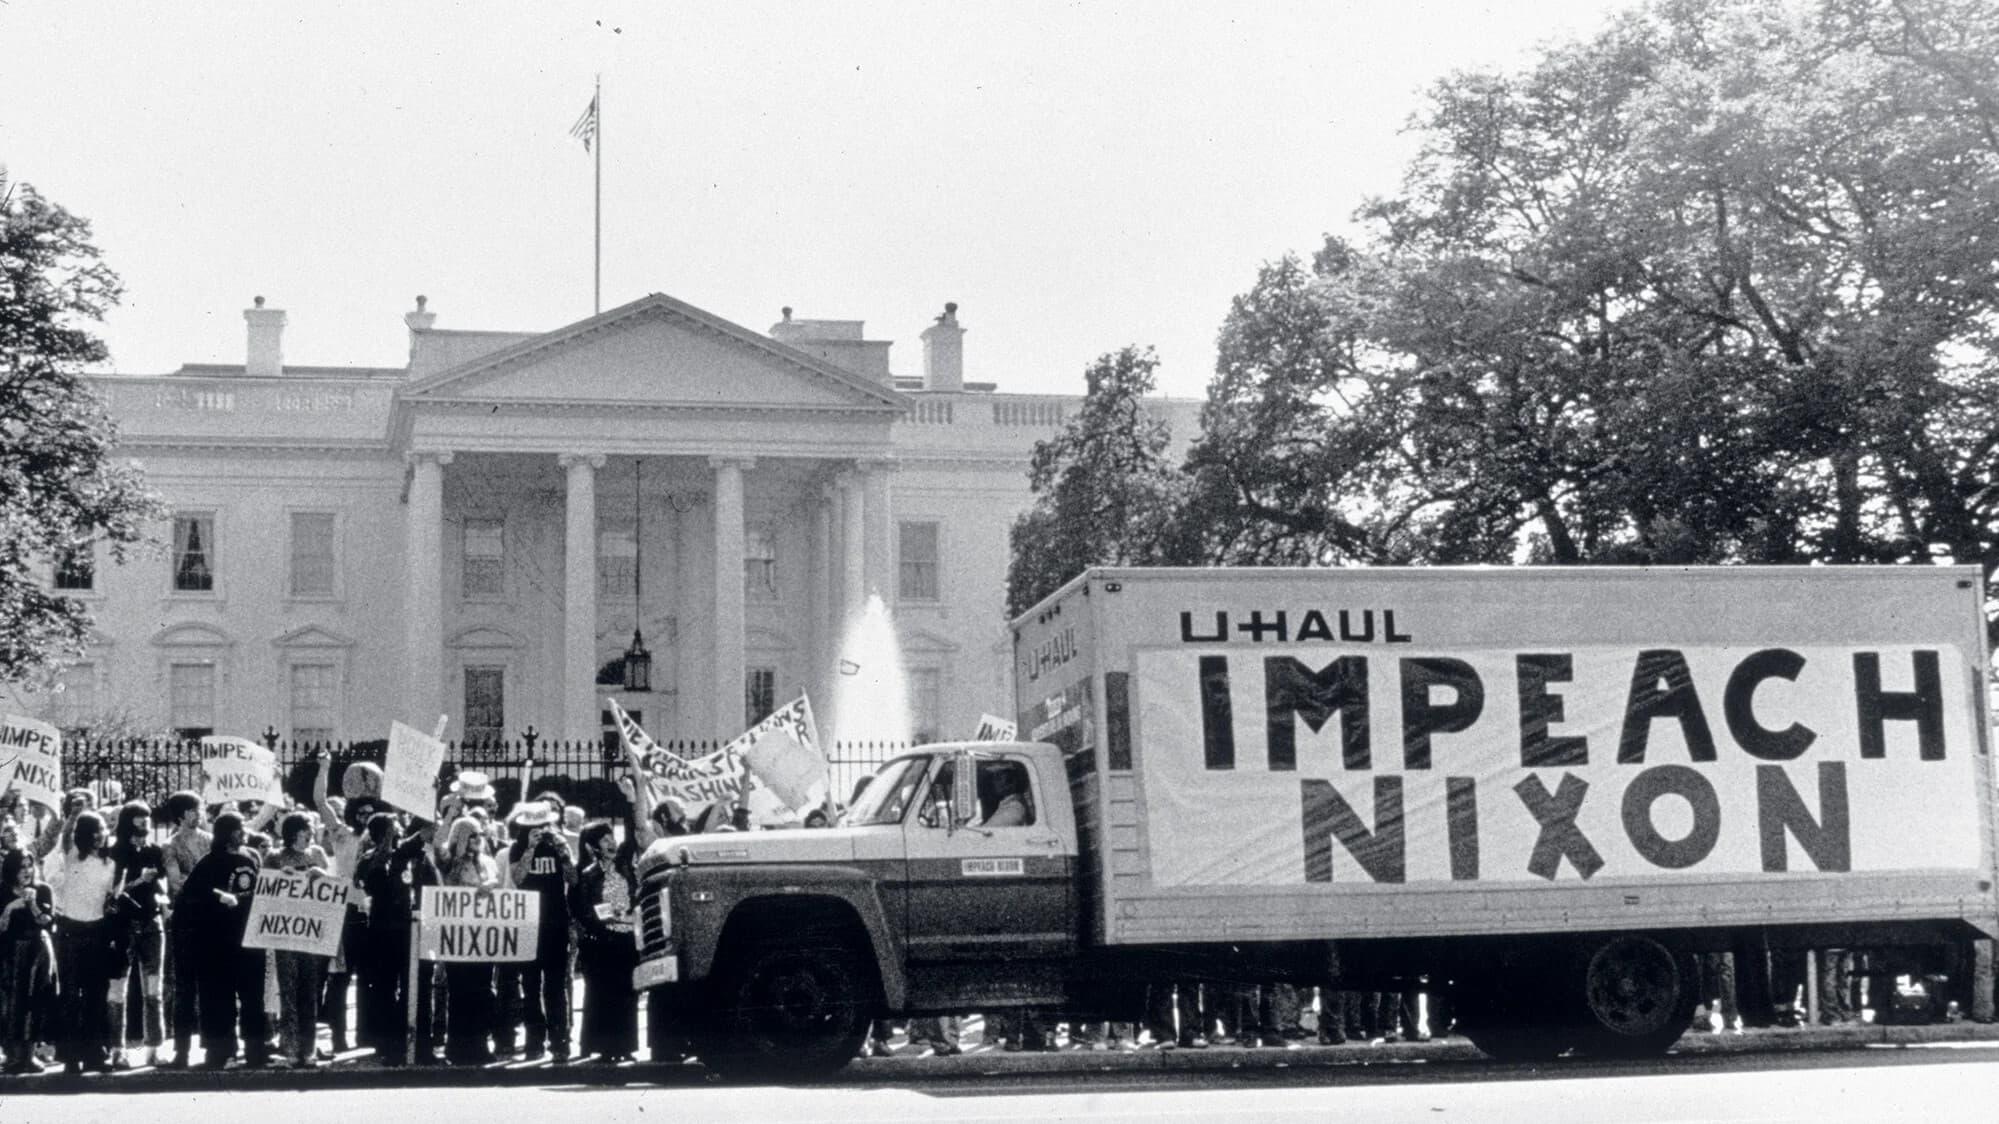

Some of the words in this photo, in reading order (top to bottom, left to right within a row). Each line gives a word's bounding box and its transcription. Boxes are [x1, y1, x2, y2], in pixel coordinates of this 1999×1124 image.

[1200, 648, 1946, 772] IMPEACH
[1300, 761, 1852, 882] NIXON
[256, 875, 349, 905] IMPEACH
[434, 890, 527, 920] IMPEACH
[260, 914, 322, 938] NIXON
[439, 924, 518, 957] NIXON
